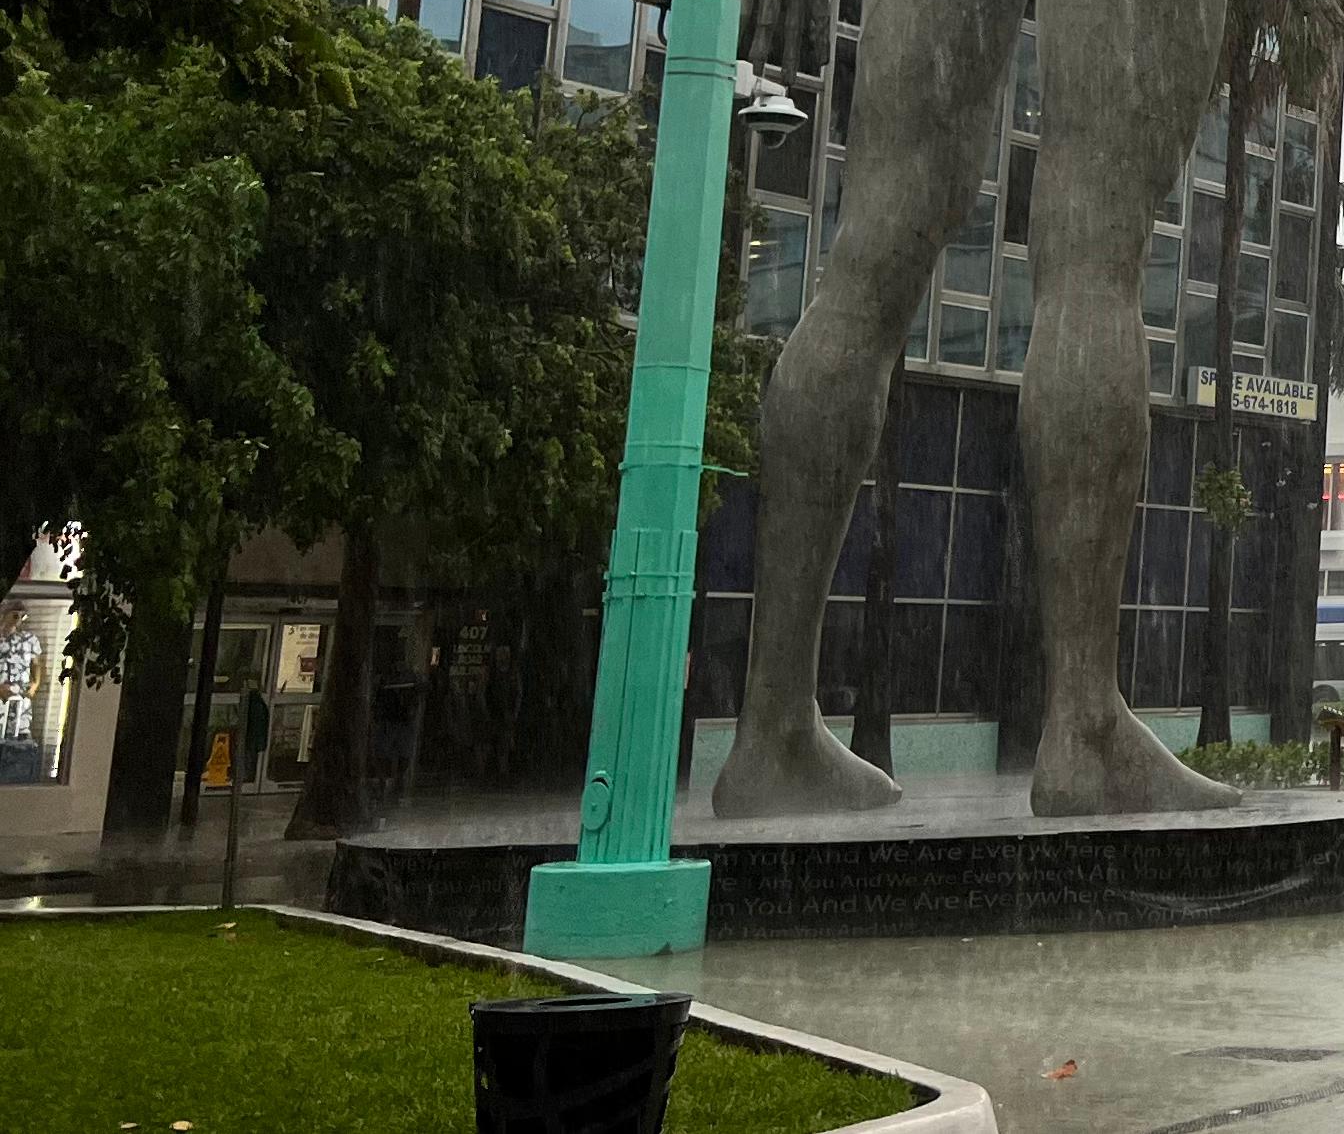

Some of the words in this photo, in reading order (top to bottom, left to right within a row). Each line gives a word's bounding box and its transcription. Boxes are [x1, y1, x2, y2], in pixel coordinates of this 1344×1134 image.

[1200, 370, 1243, 391] SPE
[1246, 376, 1314, 400] AVAILABLE
[459, 625, 489, 640] 407
[748, 846, 796, 867] You
[808, 845, 860, 865] And
[867, 843, 909, 863] We
[919, 844, 962, 862] Are
[970, 840, 1117, 861] Everywhere
[840, 872, 882, 889] And
[887, 871, 918, 886] We
[923, 871, 957, 886] Are
[961, 866, 1074, 885] Everywhere
[743, 897, 792, 916] You
[802, 893, 857, 914] And
[865, 892, 907, 913] We
[914, 891, 960, 911] Are
[968, 885, 1116, 909] Everywhere
